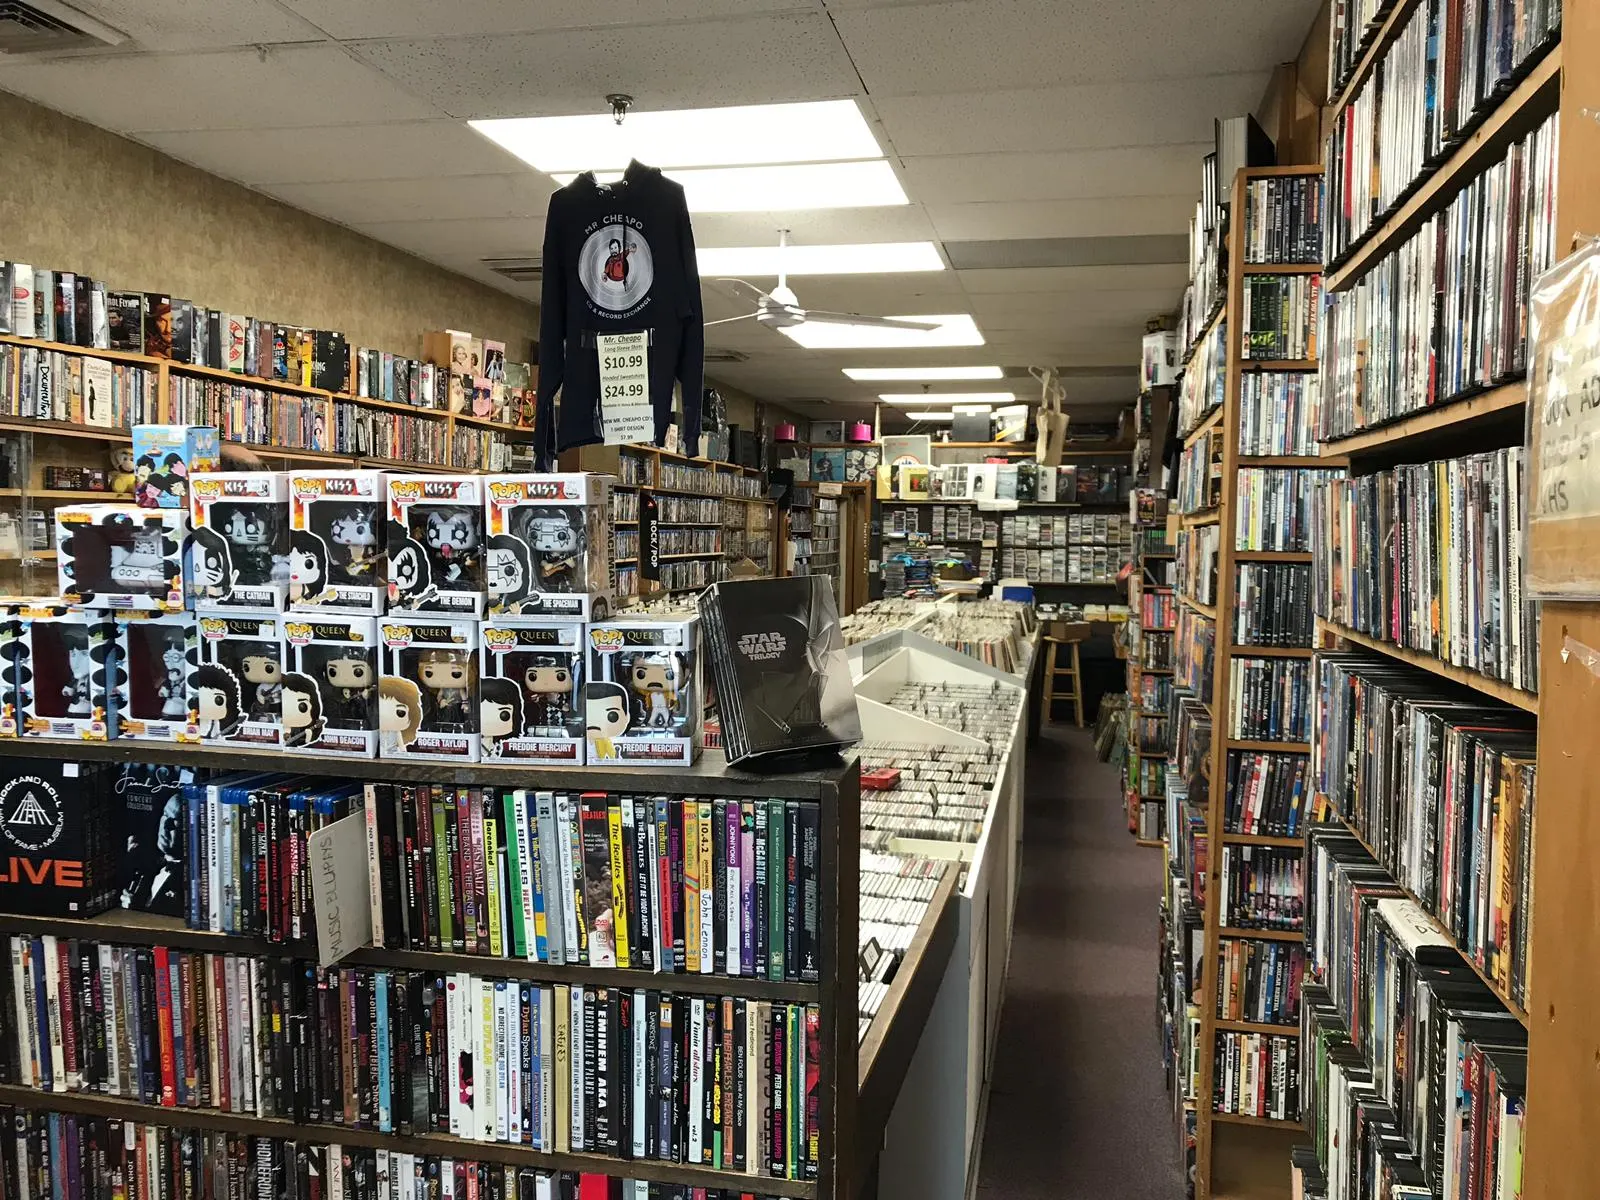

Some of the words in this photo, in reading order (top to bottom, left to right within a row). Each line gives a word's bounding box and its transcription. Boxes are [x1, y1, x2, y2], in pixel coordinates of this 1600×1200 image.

[585, 222, 598, 234] MR
[598, 310, 622, 319] RECORD
[623, 296, 652, 319] EXCHANGE
[618, 335, 641, 343] Cheapo
[605, 356, 642, 370] $10.99
[605, 384, 643, 398] $24.99
[326, 479, 352, 491] KISS
[390, 481, 419, 498] POP!
[425, 483, 453, 494] KISS
[489, 482, 521, 499] POP!
[527, 484, 558, 496] KISS
[608, 512, 616, 589] SPACEMAN
[234, 592, 246, 600] THE
[248, 591, 270, 600] CATMAN
[439, 597, 450, 606] THE
[452, 597, 472, 606] DEMON
[543, 600, 551, 608] THE
[552, 600, 579, 608] SPACEMAN
[230, 621, 258, 633] QUEEN
[316, 625, 346, 637] QUEEN
[383, 624, 412, 641] POP!
[415, 627, 448, 638] QUEEN
[484, 628, 516, 645] POP!
[521, 631, 555, 642] QUEEN
[589, 629, 623, 646] POP!
[627, 630, 662, 643] QUEEN
[737, 632, 786, 645] STAR
[738, 641, 786, 655] WARS
[748, 651, 781, 661] TRILOGY
[261, 729, 274, 737] MAY
[322, 735, 338, 744] JOHN
[339, 736, 364, 745] DEACON
[418, 738, 439, 747] ROGER
[441, 739, 467, 748] TAYLOR
[508, 743, 537, 751] FREDDIE
[539, 743, 571, 752] MERCURY
[622, 743, 649, 753] FREDDIE
[650, 743, 684, 753] MERCURY
[19, 776, 41, 784] AND
[42, 782, 62, 808] ROLL
[515, 801, 524, 824] THE
[756, 810, 765, 829] PAUL
[369, 827, 374, 839] NO
[486, 821, 494, 866] Barenaked
[637, 832, 645, 868] BEATLES
[518, 829, 528, 885] BEATLES
[613, 844, 622, 878] Beatles
[756, 838, 766, 885] McCARTNEY
[788, 856, 796, 881] back
[1502, 870, 1510, 904] CLUB
[260, 896, 267, 910] US
[522, 889, 531, 920] HELP!
[701, 893, 712, 918] John
[787, 896, 797, 913] the
[804, 878, 817, 932] ROCKSHOW
[701, 923, 712, 959] Lennon
[63, 980, 71, 1011] ROLLING
[102, 966, 113, 1021] COLDPLAY
[585, 1006, 594, 1038] EMERSON
[585, 1040, 594, 1057] LAKE
[598, 1010, 606, 1072] EMINEM
[521, 1035, 530, 1068] Speaks
[585, 1068, 595, 1095] PALMER
[598, 1077, 607, 1108] AKA
[504, 1170, 514, 1198] Jethro
